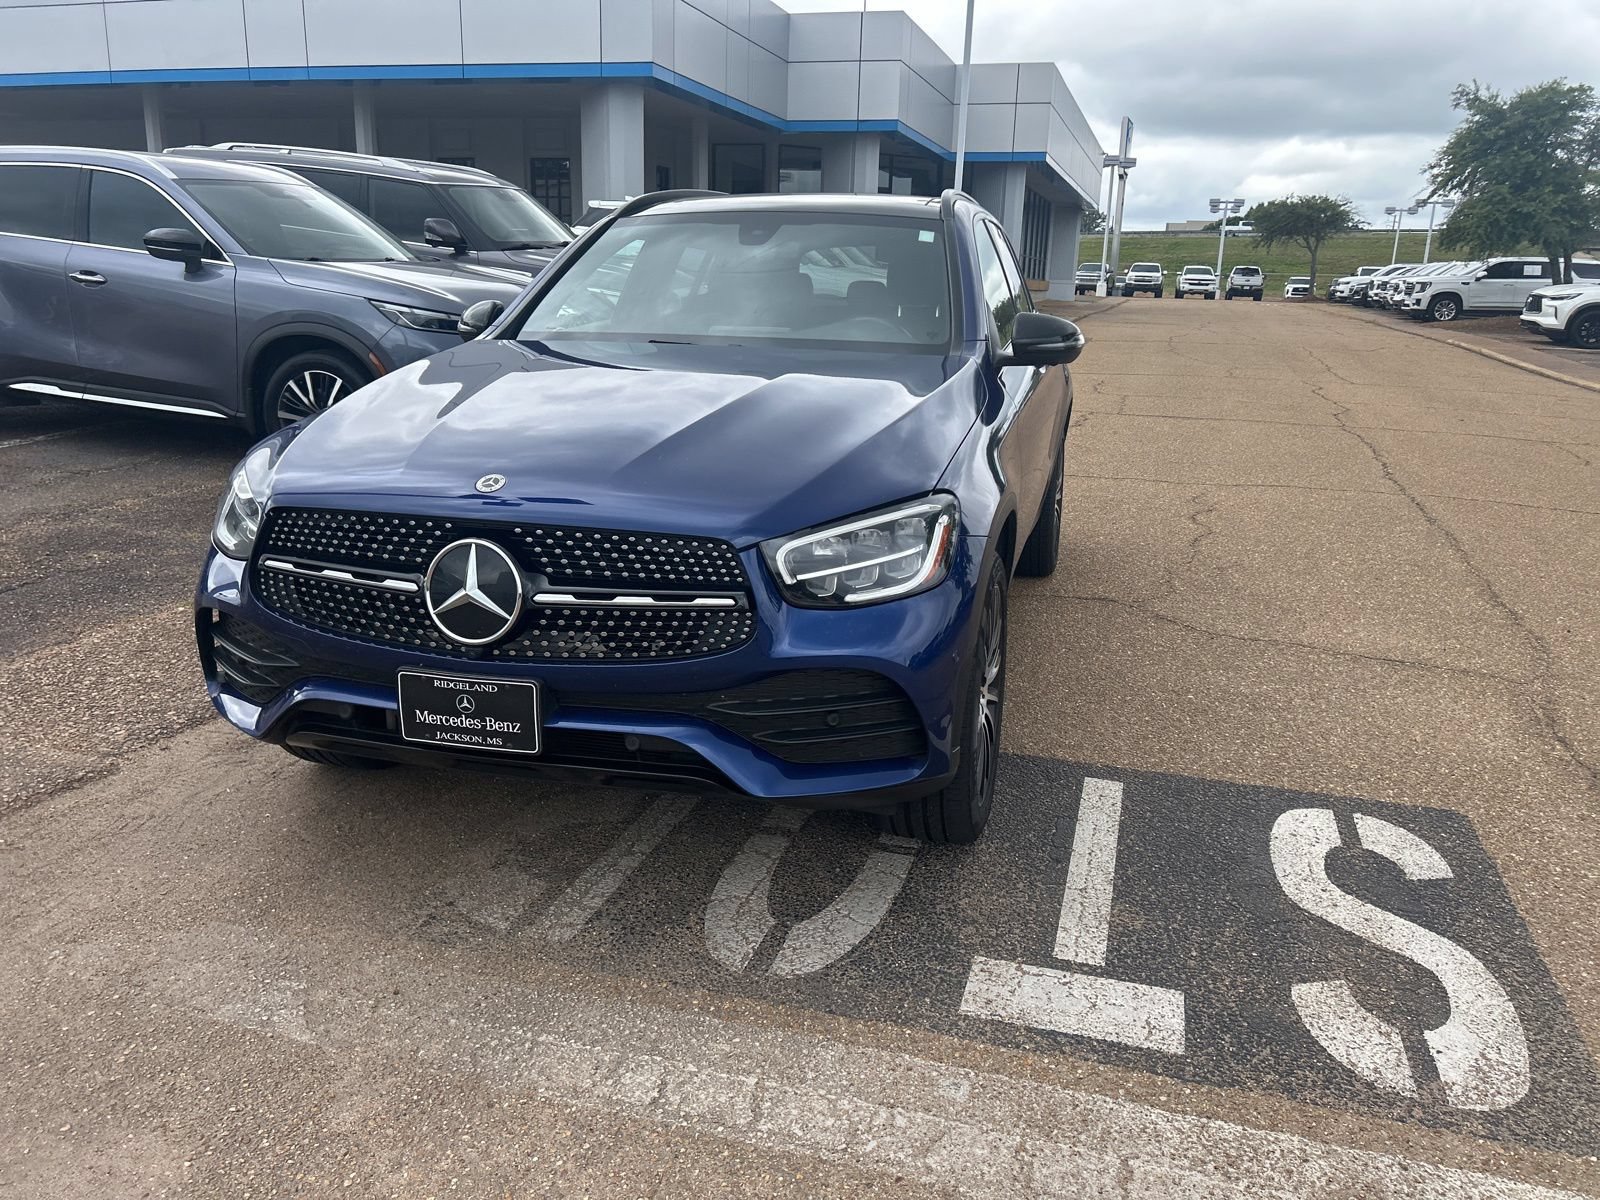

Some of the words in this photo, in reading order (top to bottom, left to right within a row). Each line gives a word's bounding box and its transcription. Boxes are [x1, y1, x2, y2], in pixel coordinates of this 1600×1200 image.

[433, 679, 498, 693] RIDGELAND
[414, 709, 521, 733] Mercedes-Benz
[486, 737, 503, 745] MS
